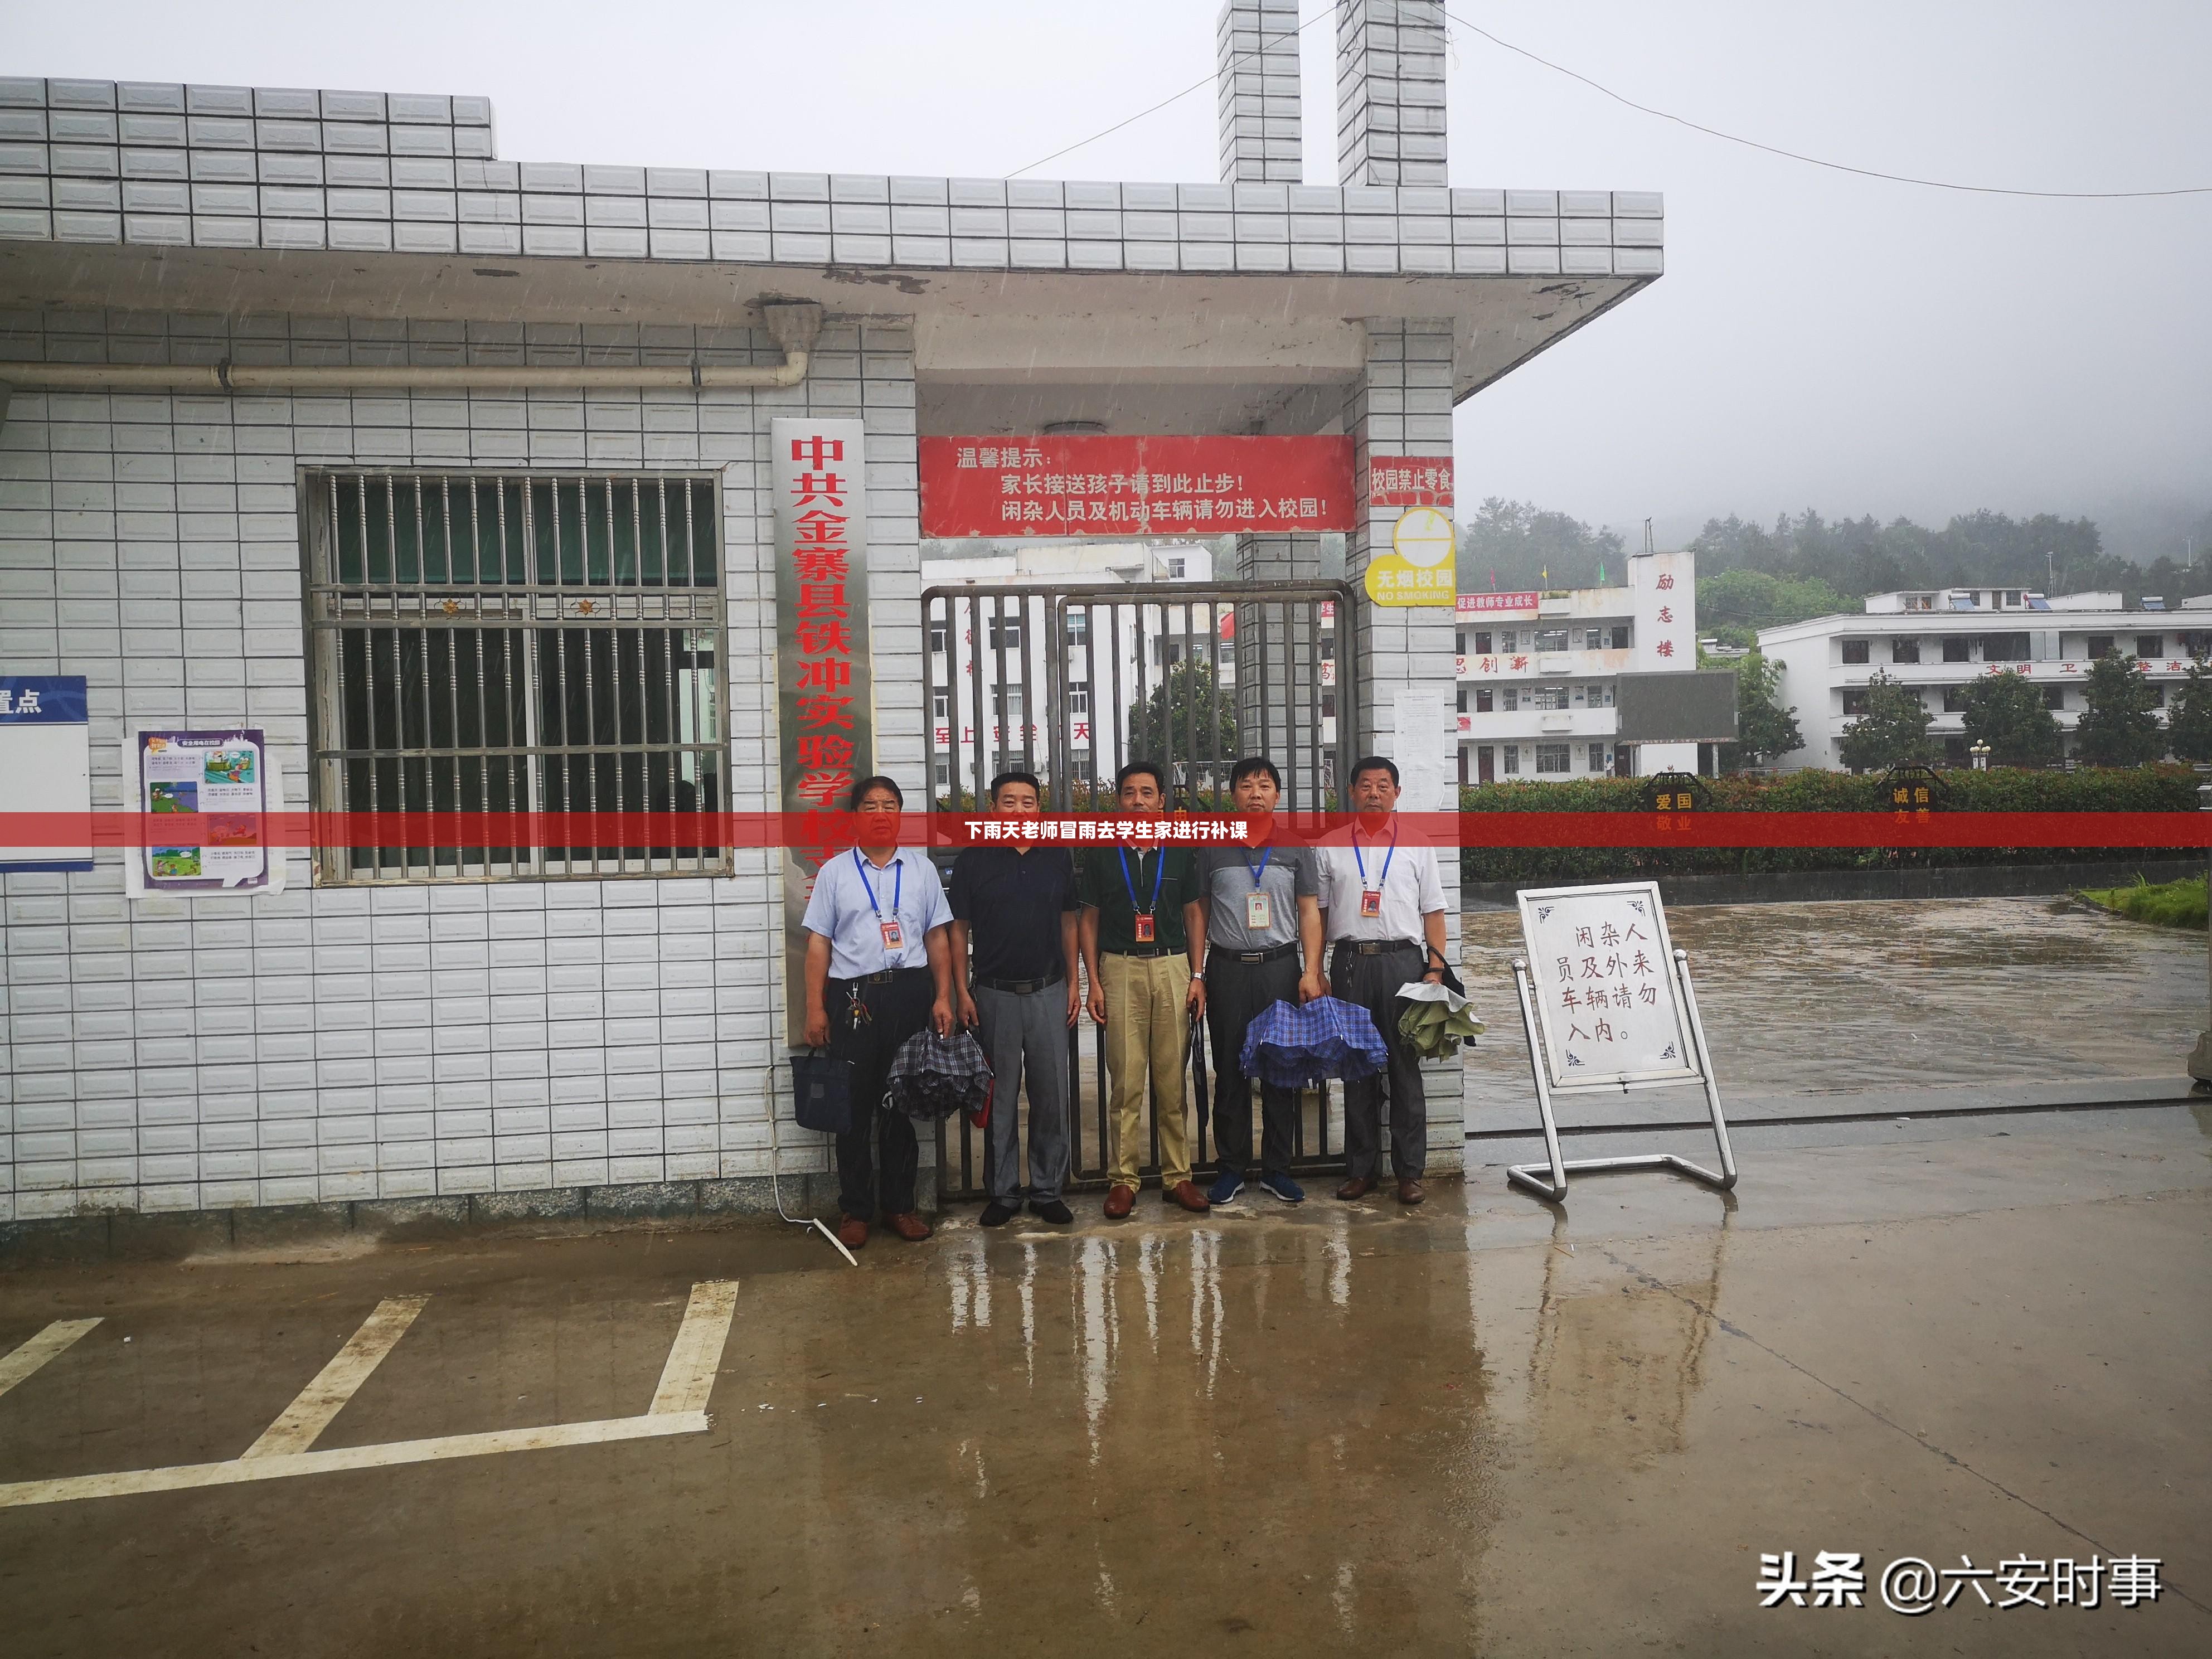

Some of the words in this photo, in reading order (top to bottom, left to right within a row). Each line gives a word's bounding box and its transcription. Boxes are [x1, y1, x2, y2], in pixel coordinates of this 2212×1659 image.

[956, 447, 1051, 468] 温馨提示：
[1000, 473, 1244, 495] 家长接送孩子请到此止步！
[1371, 468, 1451, 491] 校园禁止零食
[1001, 498, 1327, 522] 闲杂人员及机动车辆请勿进入校园！
[1377, 569, 1453, 588] 无烟校园
[1377, 592, 1394, 601] NO
[1396, 590, 1449, 600] SMOKING
[1457, 595, 1533, 609] 促进教师专业成长
[1656, 573, 1675, 657] 励志楼
[1986, 663, 2031, 675] 文明
[790, 435, 856, 941] 中共金寨县铁冲实验学校支
[1656, 793, 1692, 810] 爱国
[1893, 787, 1929, 804] 诚信
[1656, 815, 1692, 831] 敬业
[1894, 807, 1931, 824] 友善
[1575, 921, 1648, 948] 闲杂人
[1556, 949, 1655, 983] 员及外来
[1561, 982, 1657, 1014] 车辆请勿
[1568, 1017, 1628, 1042] 入内。
